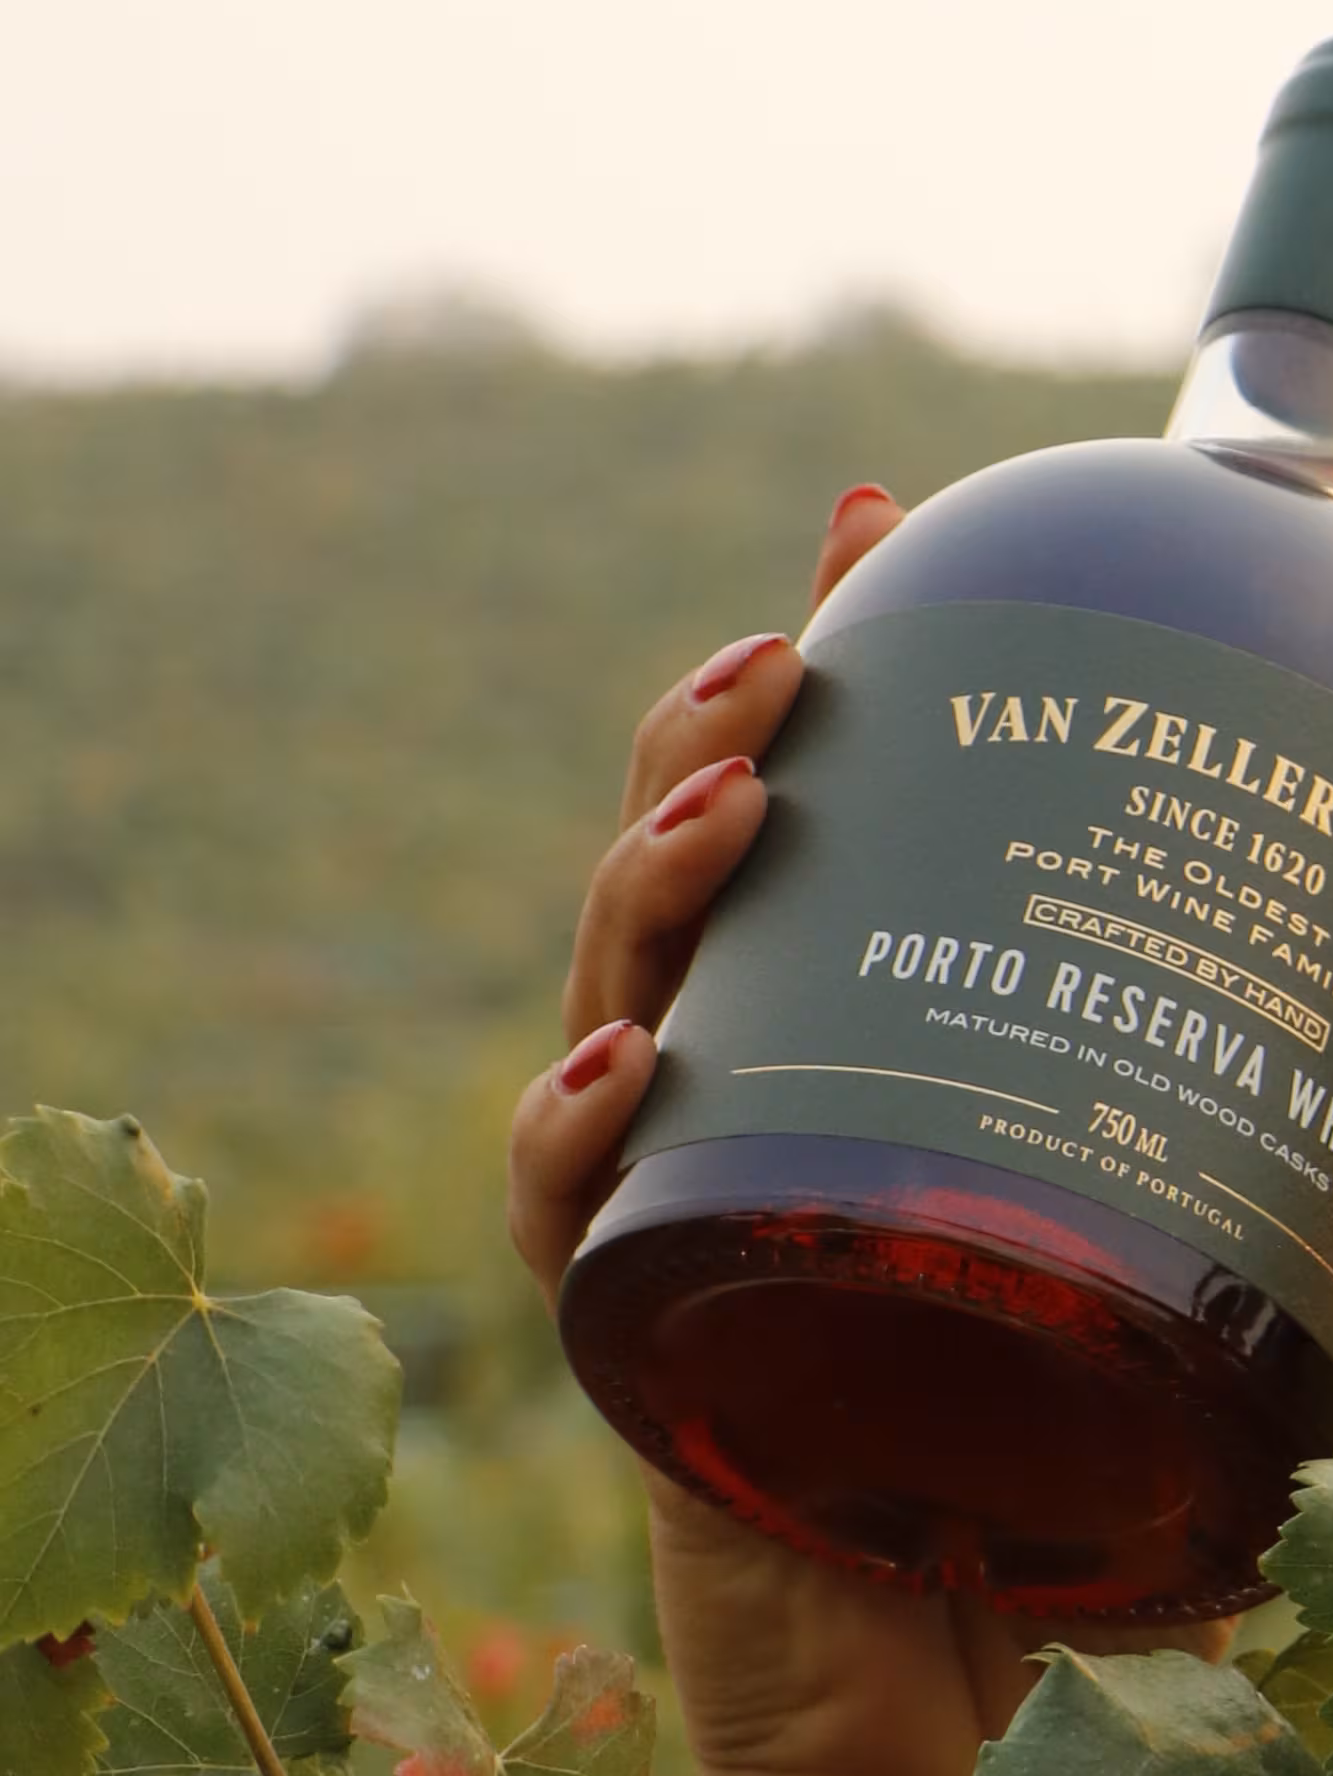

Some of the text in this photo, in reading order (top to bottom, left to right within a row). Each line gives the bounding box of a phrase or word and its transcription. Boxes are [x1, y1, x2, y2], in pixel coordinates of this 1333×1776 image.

[950, 692, 1078, 746] VAN
[1006, 841, 1119, 886] PORT
[1136, 874, 1235, 934] WINE
[1088, 826, 1331, 948] THE OLDEST
[1125, 785, 1325, 896] SINCE 1620
[859, 931, 1025, 996] PORTO
[1047, 962, 1265, 1096] RESERVA
[1034, 903, 1324, 1042] CRAFTED BY HAND
[926, 1007, 1331, 1192] MATURED IN OLD WOOD CASKS
[1088, 1102, 1135, 1147] 750
[979, 1115, 1246, 1240] PRODUCT OF PORTUGAL
